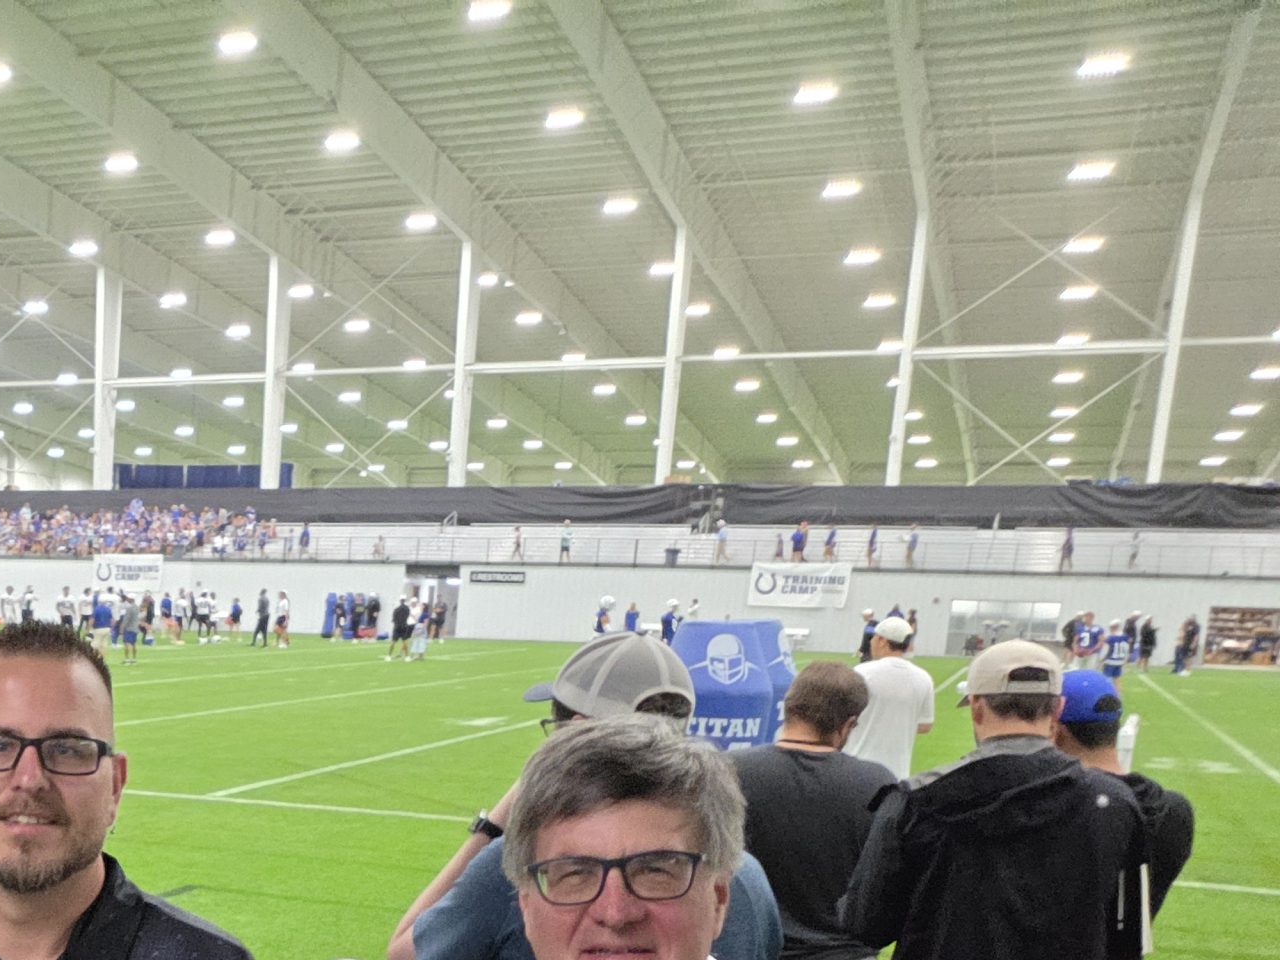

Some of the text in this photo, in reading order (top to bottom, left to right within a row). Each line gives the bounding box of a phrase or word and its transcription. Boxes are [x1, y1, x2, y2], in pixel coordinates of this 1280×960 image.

[115, 564, 160, 573] TRAINING
[115, 573, 141, 581] CAMP
[782, 575, 846, 585] TRAINING
[781, 585, 818, 594] CAMP
